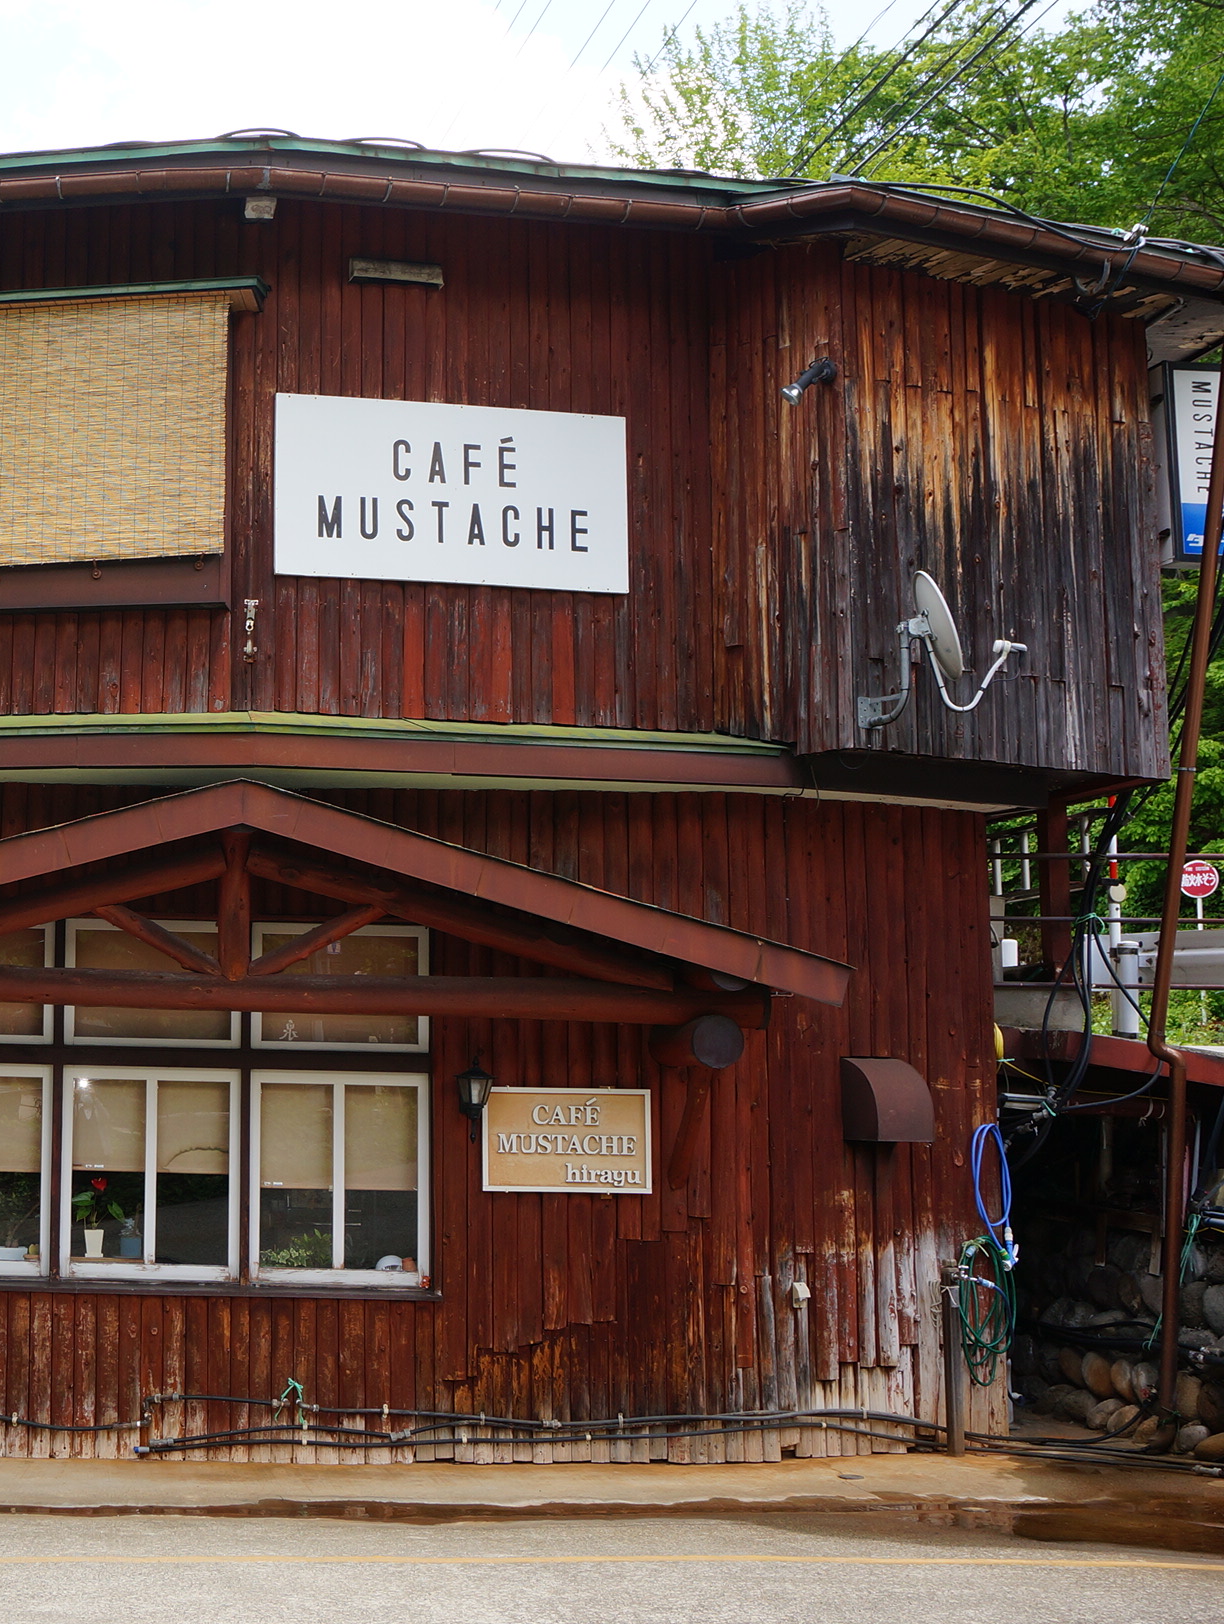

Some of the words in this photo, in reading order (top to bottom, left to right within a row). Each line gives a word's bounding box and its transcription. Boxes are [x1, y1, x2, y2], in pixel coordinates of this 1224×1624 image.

[392, 436, 517, 488] CAFÉ
[317, 494, 589, 552] MUSTACHE
[532, 1097, 601, 1126] CAFÉ
[497, 1133, 637, 1156] MUSTACHE
[565, 1162, 642, 1187] hirayu
